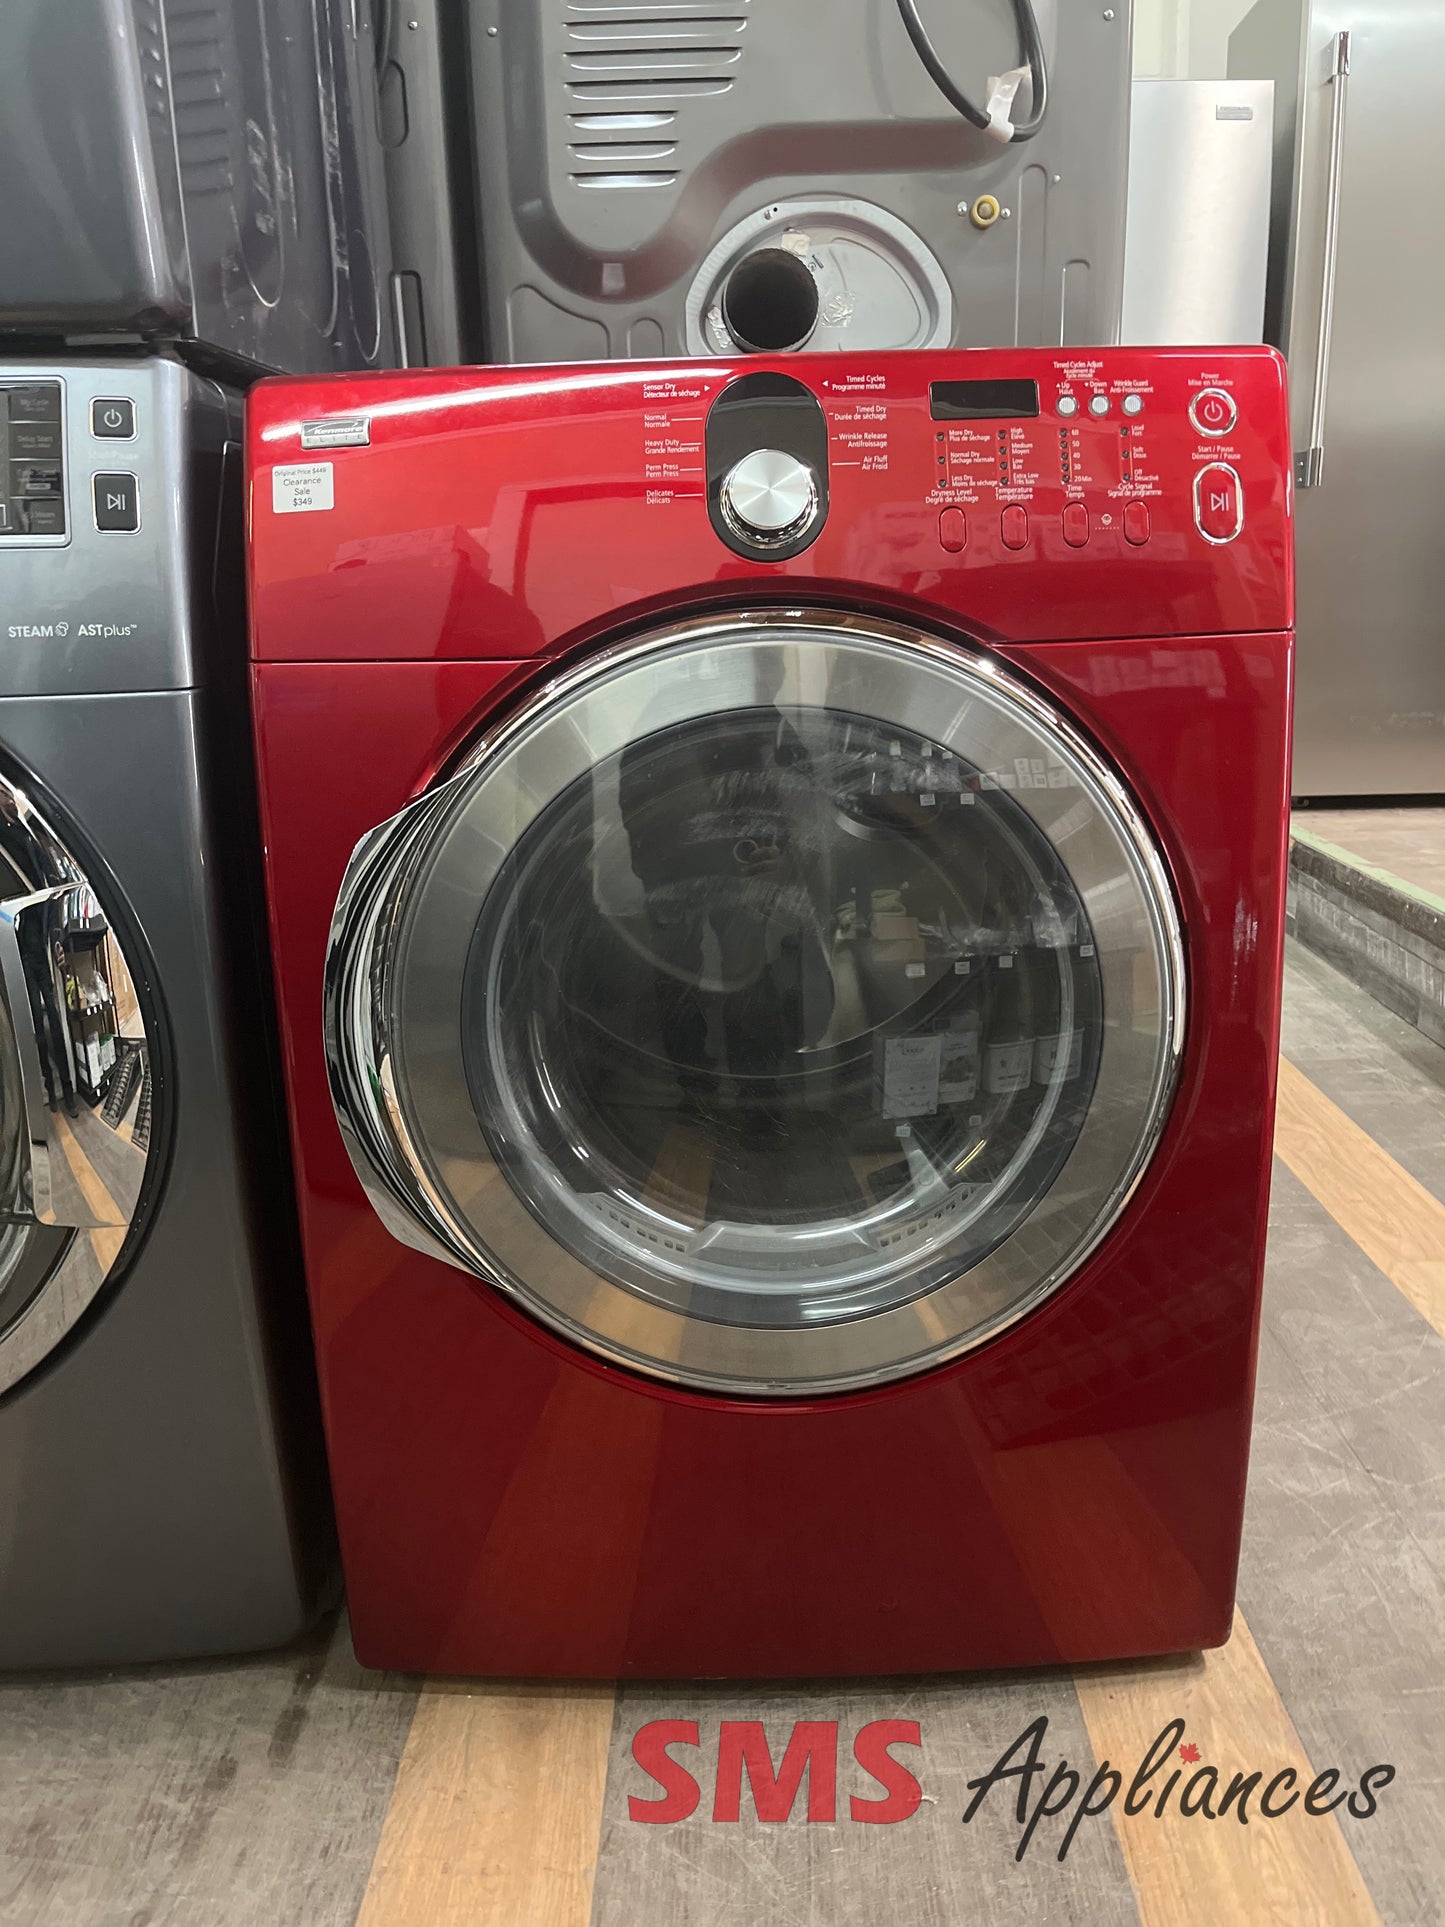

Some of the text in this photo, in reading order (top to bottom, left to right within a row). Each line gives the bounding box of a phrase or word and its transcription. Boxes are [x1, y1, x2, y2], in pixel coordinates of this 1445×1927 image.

[1070, 361, 1086, 369] Cycles
[1087, 361, 1103, 369] Adjust
[866, 375, 886, 384] Cycles
[665, 383, 676, 392] Dry
[832, 384, 865, 392] Programme
[1061, 382, 1070, 390] Up
[643, 391, 669, 399] Détecteur
[678, 389, 701, 398] séchage
[644, 413, 667, 421] Normal
[835, 413, 852, 421] Durée
[863, 413, 887, 421] séchage
[314, 426, 362, 435] Kenmore
[964, 429, 973, 437] Dry
[645, 439, 679, 448] Heavy Duty
[848, 440, 888, 448] Antifroissage
[970, 451, 980, 459] Dry
[274, 470, 297, 478] Original
[964, 474, 973, 482] Dry
[283, 478, 322, 487] Clearance
[1118, 482, 1152, 491] Cycle Signal
[294, 487, 310, 495] Sale
[931, 490, 955, 498] Dryness
[1065, 491, 1085, 499] Temps
[1107, 490, 1123, 498] Signal
[1132, 489, 1162, 498] programme
[293, 497, 313, 507] $349
[646, 496, 671, 504] Délicats
[954, 495, 979, 504] séchage
[8, 625, 54, 638] STEAM
